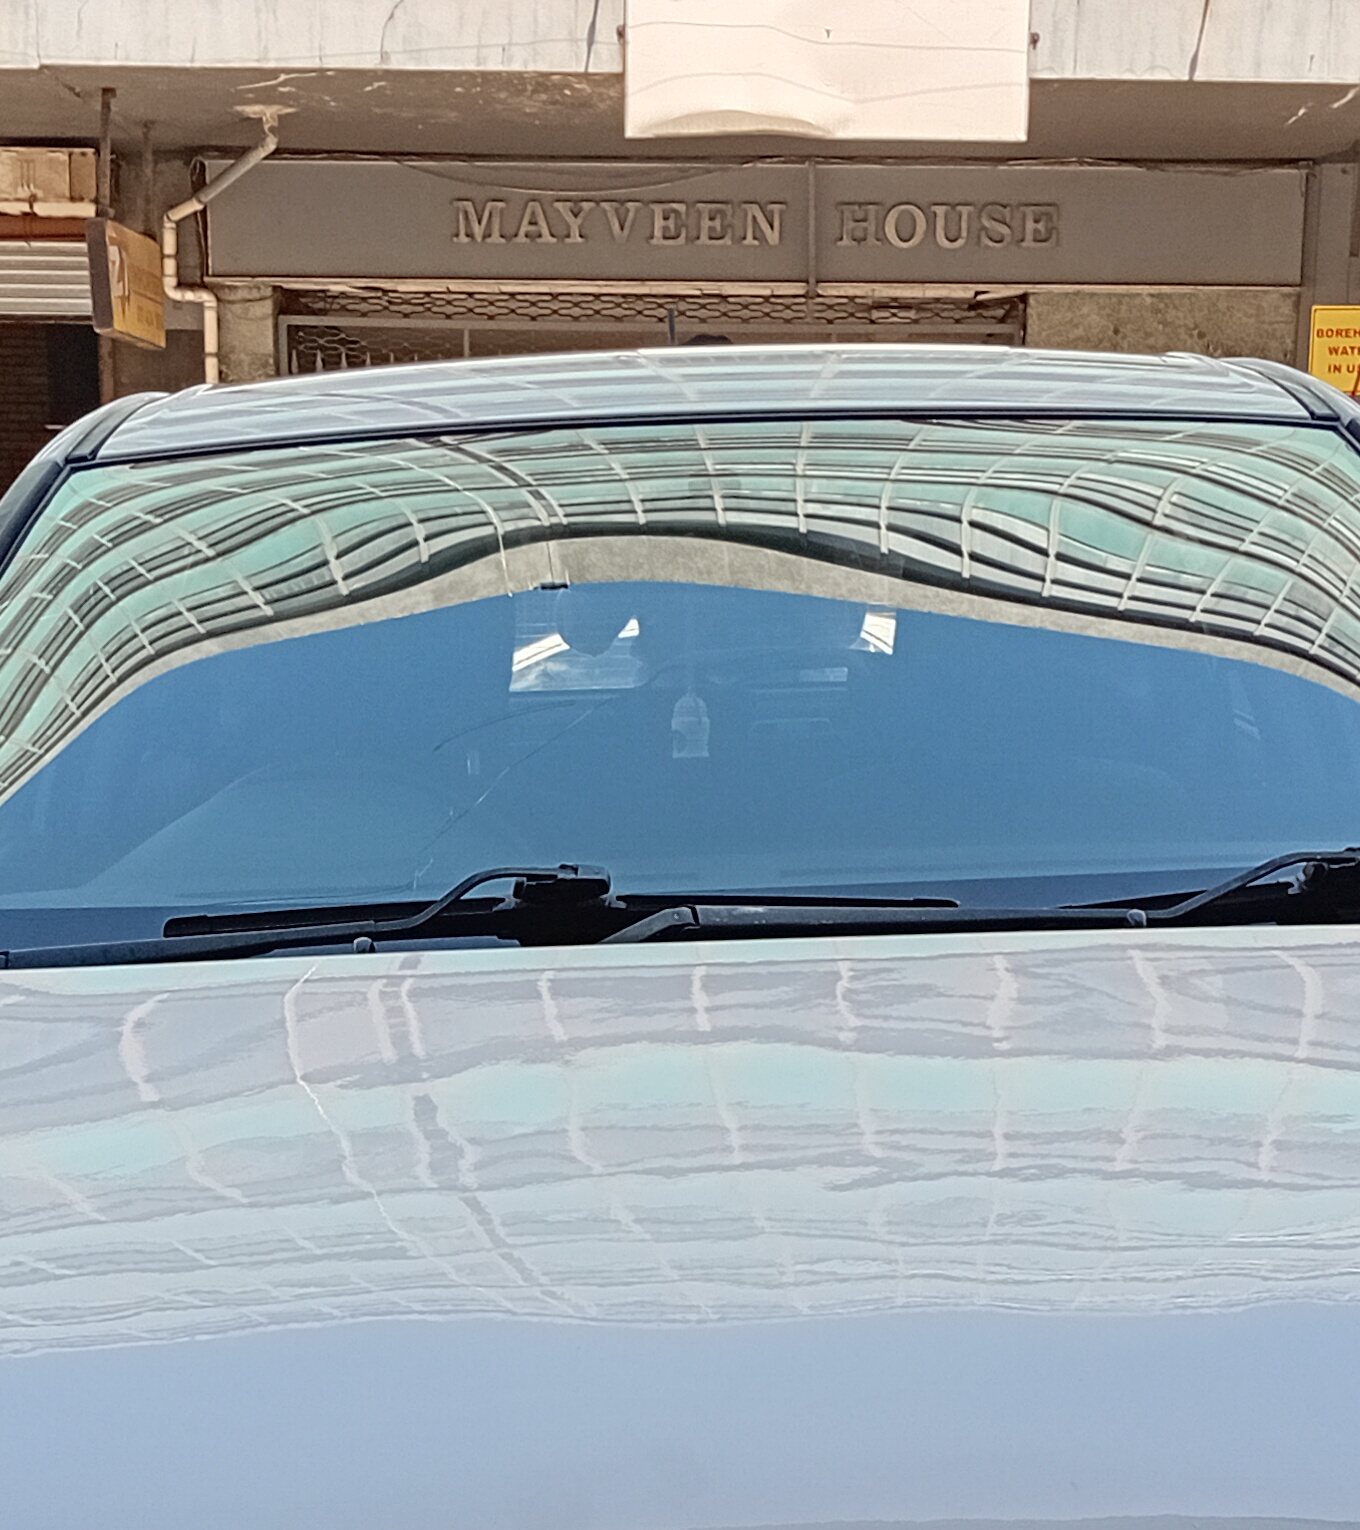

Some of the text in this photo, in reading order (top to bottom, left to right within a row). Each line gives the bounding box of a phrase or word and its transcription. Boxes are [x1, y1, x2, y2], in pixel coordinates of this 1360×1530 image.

[452, 200, 1061, 249] MAYVEEN HOUSE
[1328, 363, 1342, 374] IN
